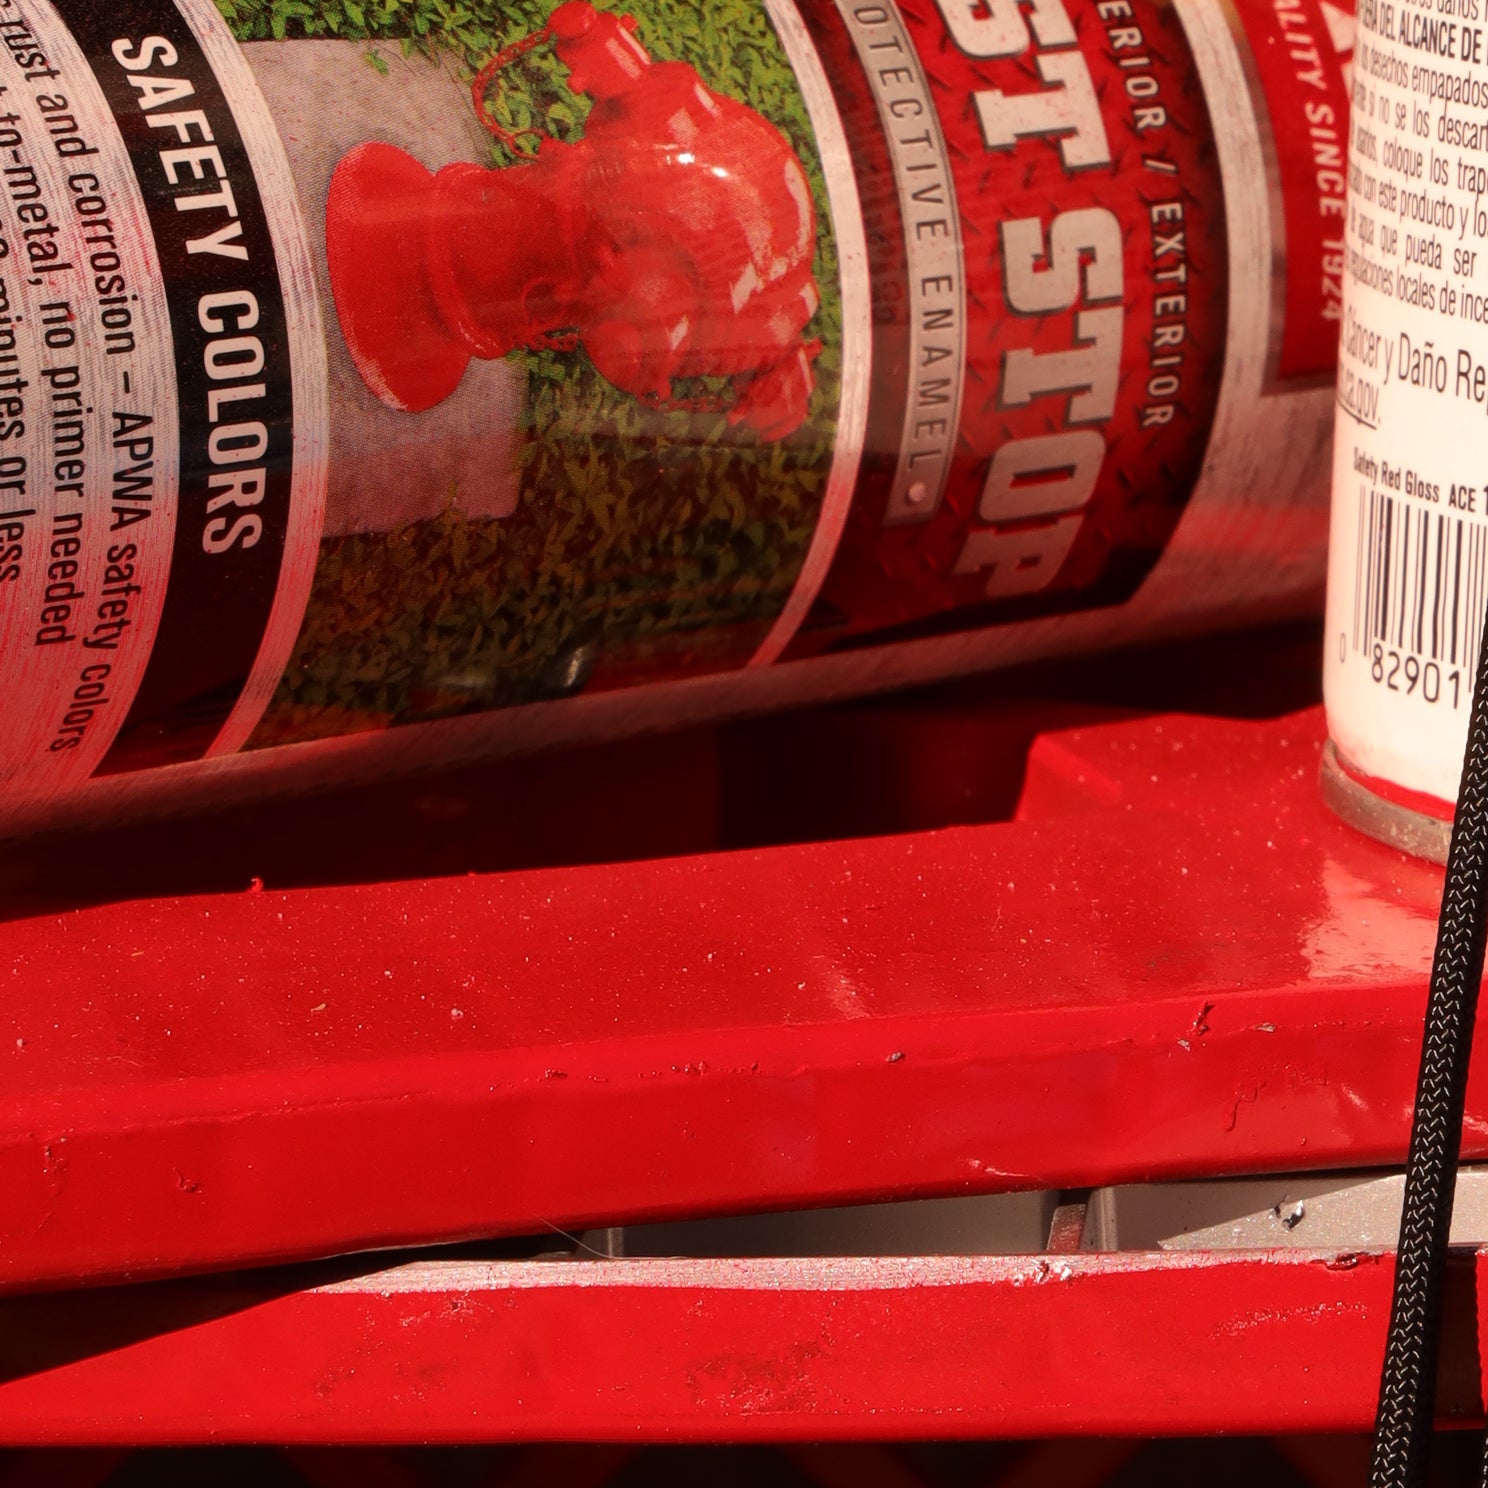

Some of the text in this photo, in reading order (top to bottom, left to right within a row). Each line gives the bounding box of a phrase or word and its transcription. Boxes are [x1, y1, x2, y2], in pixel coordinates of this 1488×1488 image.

[1398, 10, 1457, 59] ALCANCE
[1460, 25, 1482, 64] DE
[1411, 65, 1488, 115] empapados
[1412, 100, 1430, 139] los
[1304, 99, 1346, 217] SINCE
[1383, 136, 1423, 180] coloque
[1429, 148, 1449, 187] los
[1399, 186, 1455, 231] producto
[1320, 238, 1346, 322] 1924
[1405, 231, 1442, 271] pueda
[1453, 247, 1477, 279] ser
[111, 35, 269, 554] SAFETY COLORS
[1143, 201, 1187, 428] EXTERIOR
[1399, 268, 1435, 311] locales
[1439, 279, 1456, 316] de
[0, 113, 94, 647] to-metal, no primer needed
[0, 19, 155, 753] rust and corrosion APWA safety colors
[907, 272, 954, 471] ENAMEL
[1399, 332, 1447, 394] Daño
[952, 206, 1125, 597] STOP
[0, 455, 27, 498] or
[1354, 446, 1379, 487] Safety
[1381, 460, 1402, 493] Red
[1405, 470, 1440, 504] Gloss
[1448, 483, 1476, 514] ACE
[0, 509, 37, 582] less
[1372, 642, 1460, 710] 82901
